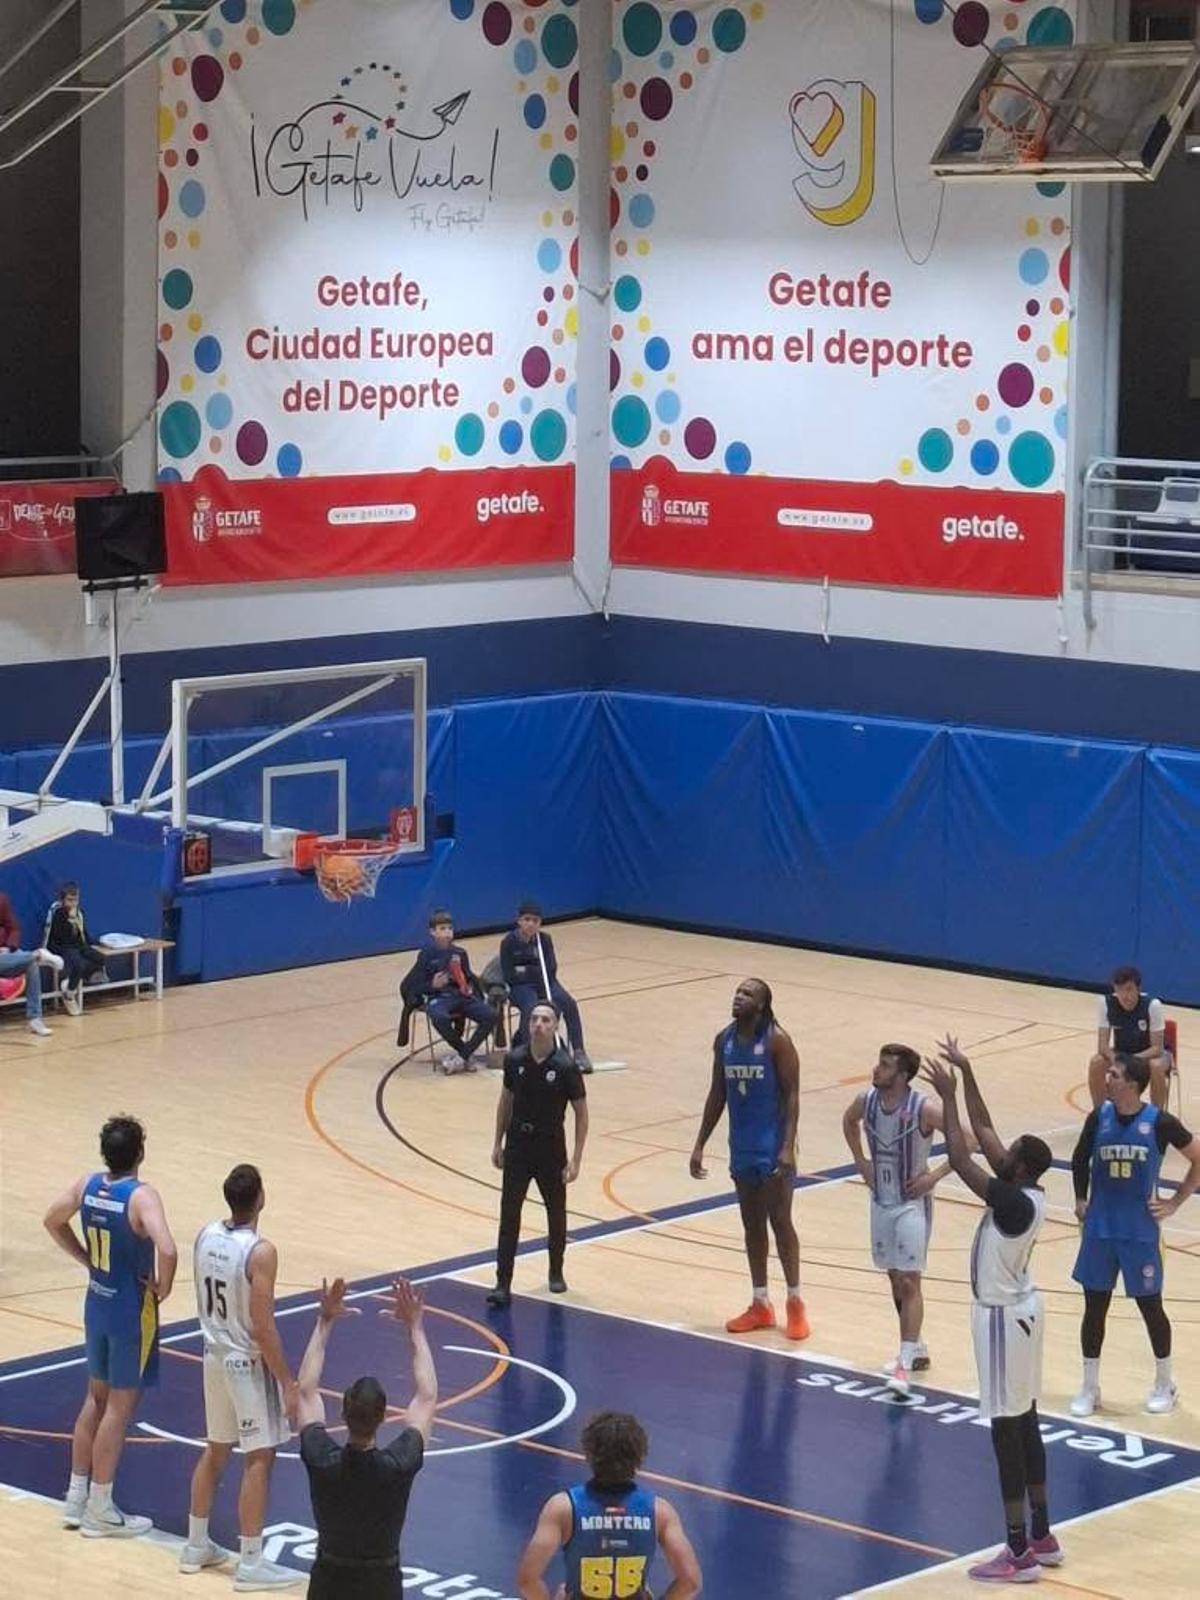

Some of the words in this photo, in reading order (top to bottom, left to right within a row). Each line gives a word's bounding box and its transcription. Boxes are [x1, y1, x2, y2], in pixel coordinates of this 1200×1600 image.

[389, 128, 499, 201] Vuela!
[317, 272, 428, 310] Getafe,
[768, 271, 892, 308] Getafe
[246, 326, 361, 360] Ciudad
[370, 327, 493, 367] Europea
[692, 331, 774, 361] ama
[783, 328, 813, 362] el
[824, 329, 973, 377] deporte
[282, 379, 330, 412] del
[339, 378, 459, 420] Deporte
[215, 510, 261, 527] GETAFE
[476, 490, 545, 522] getafe.
[664, 500, 710, 516] GETAFE
[942, 515, 1025, 543] getafe.
[87, 1226, 110, 1273] 11
[205, 1277, 227, 1320] 15
[581, 1515, 651, 1531] MONTERO
